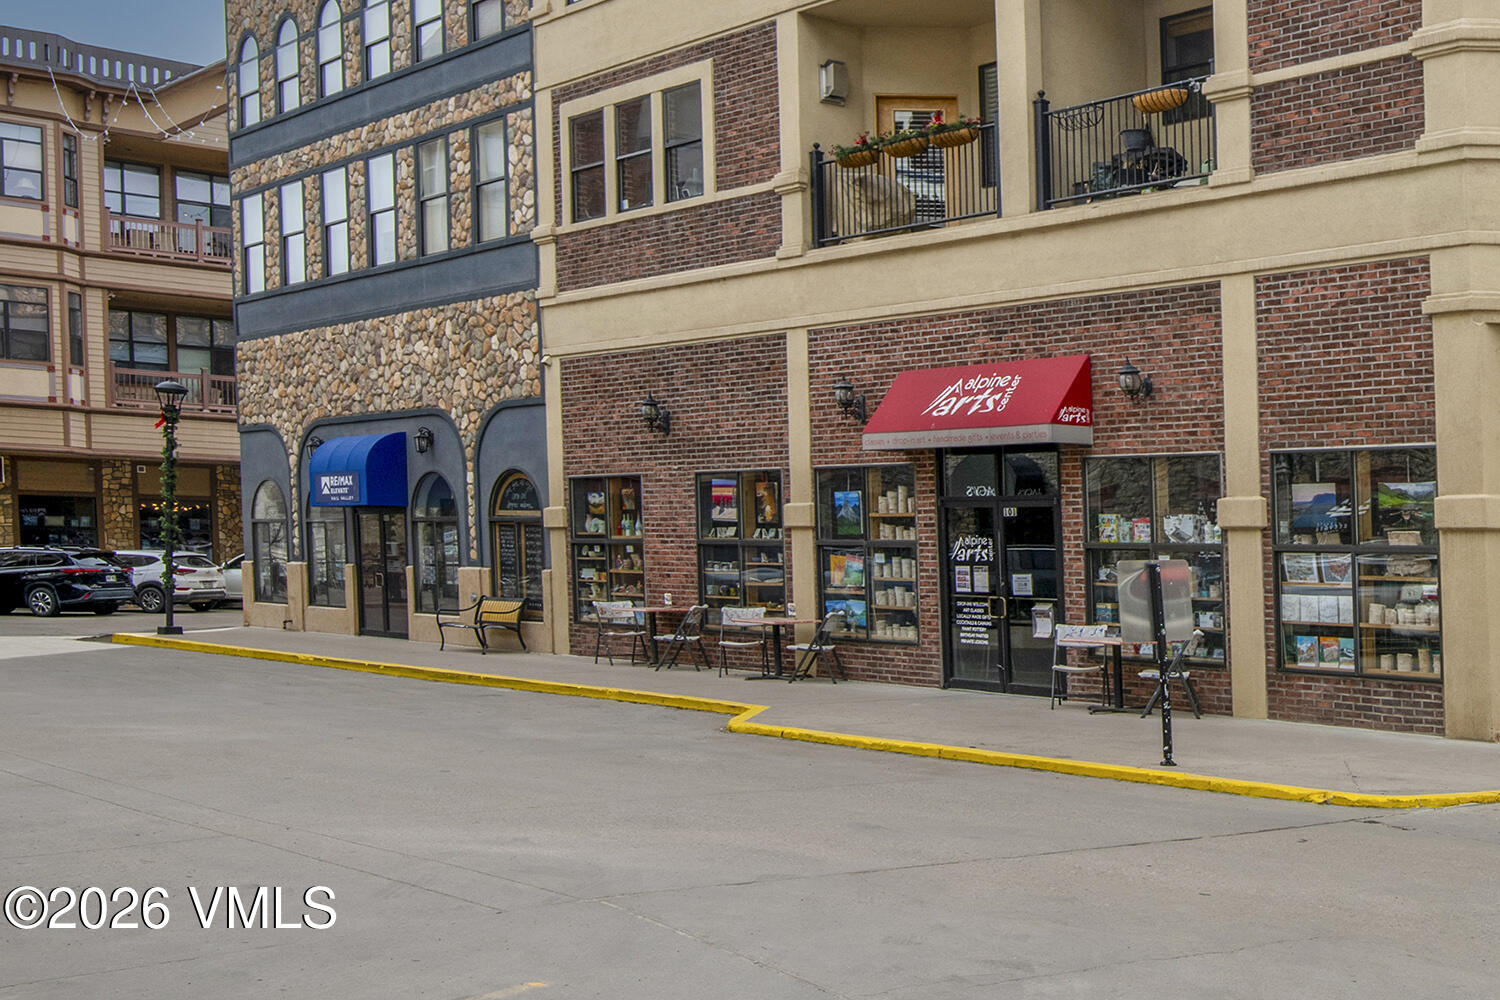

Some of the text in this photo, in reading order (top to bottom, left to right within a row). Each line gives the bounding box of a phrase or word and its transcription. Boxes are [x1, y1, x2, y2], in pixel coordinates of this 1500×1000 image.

[964, 372, 1012, 393] alpine
[996, 374, 1022, 412] center
[932, 387, 1003, 416] arts
[1061, 412, 1087, 424] arts
[968, 432, 983, 445] gifts
[331, 475, 352, 486] RE/MAX
[1003, 507, 1017, 517] 101
[964, 534, 988, 547] alpine
[956, 545, 988, 562] arts
